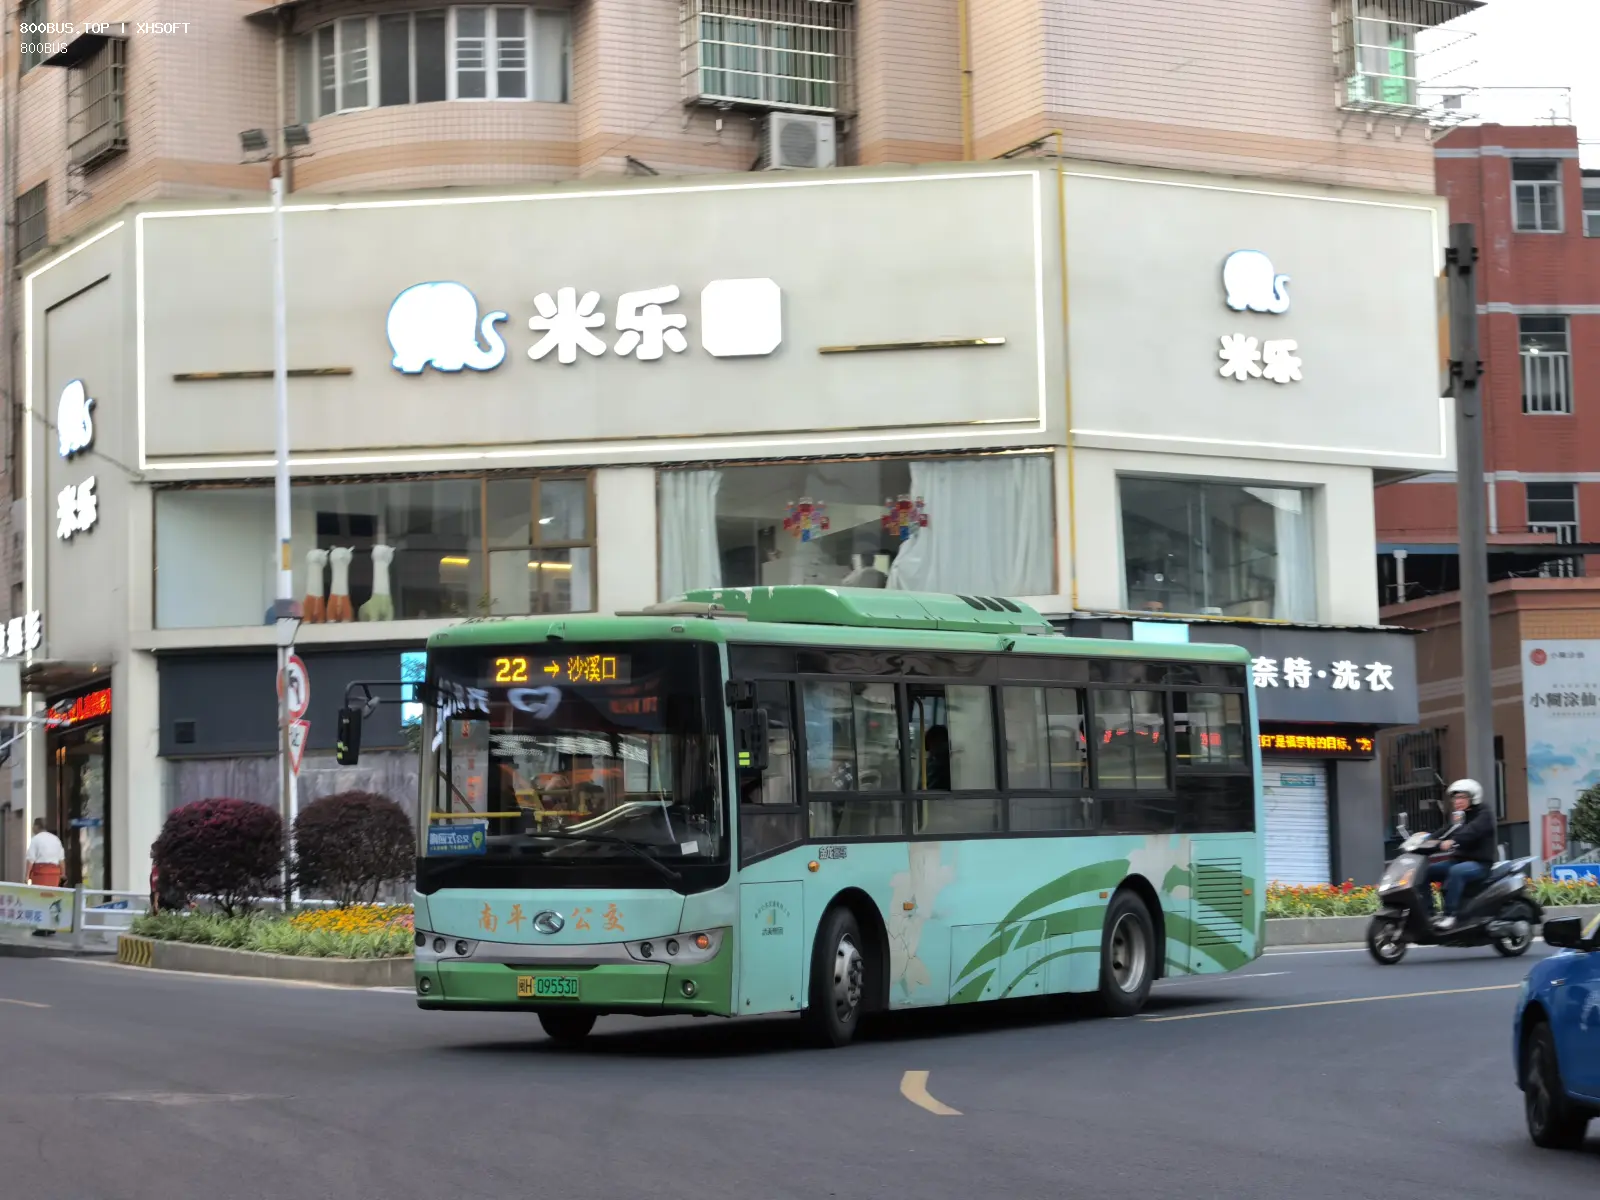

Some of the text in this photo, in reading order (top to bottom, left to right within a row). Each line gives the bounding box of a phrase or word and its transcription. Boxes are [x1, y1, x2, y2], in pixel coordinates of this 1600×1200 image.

[1219, 332, 1303, 383] 米乐
[495, 655, 616, 682] 22 沙溪口
